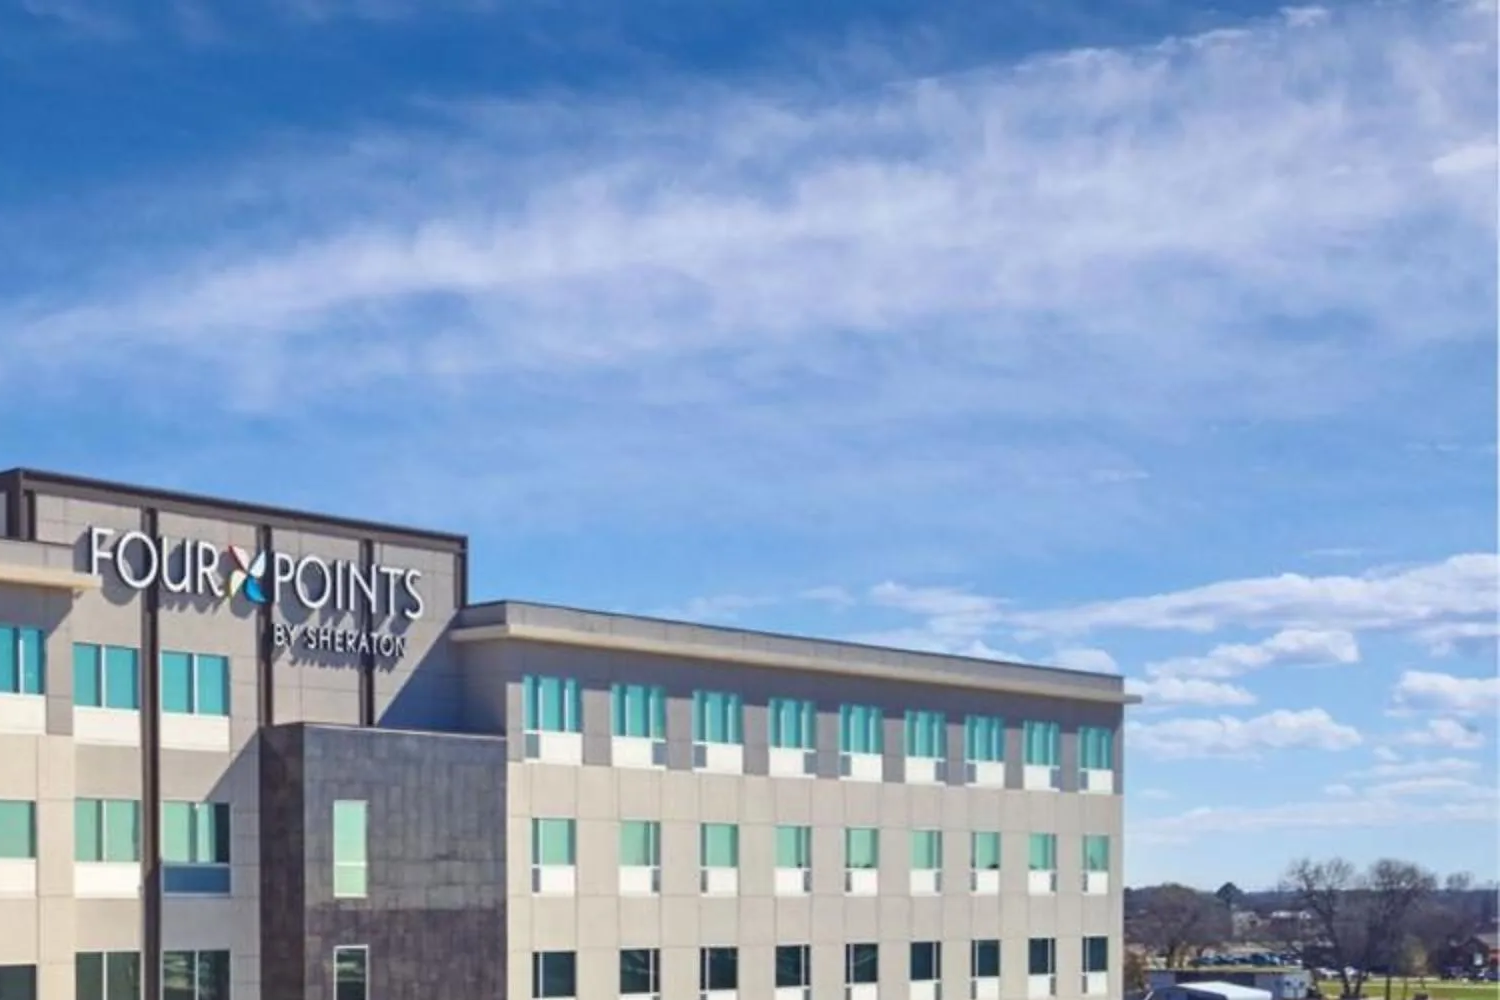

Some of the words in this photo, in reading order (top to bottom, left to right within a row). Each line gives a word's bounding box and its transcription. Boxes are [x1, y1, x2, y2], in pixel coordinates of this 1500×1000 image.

[88, 526, 224, 598] FOUR
[273, 552, 425, 621] POINTS
[273, 622, 299, 649] BY
[306, 625, 407, 657] SHERATON
